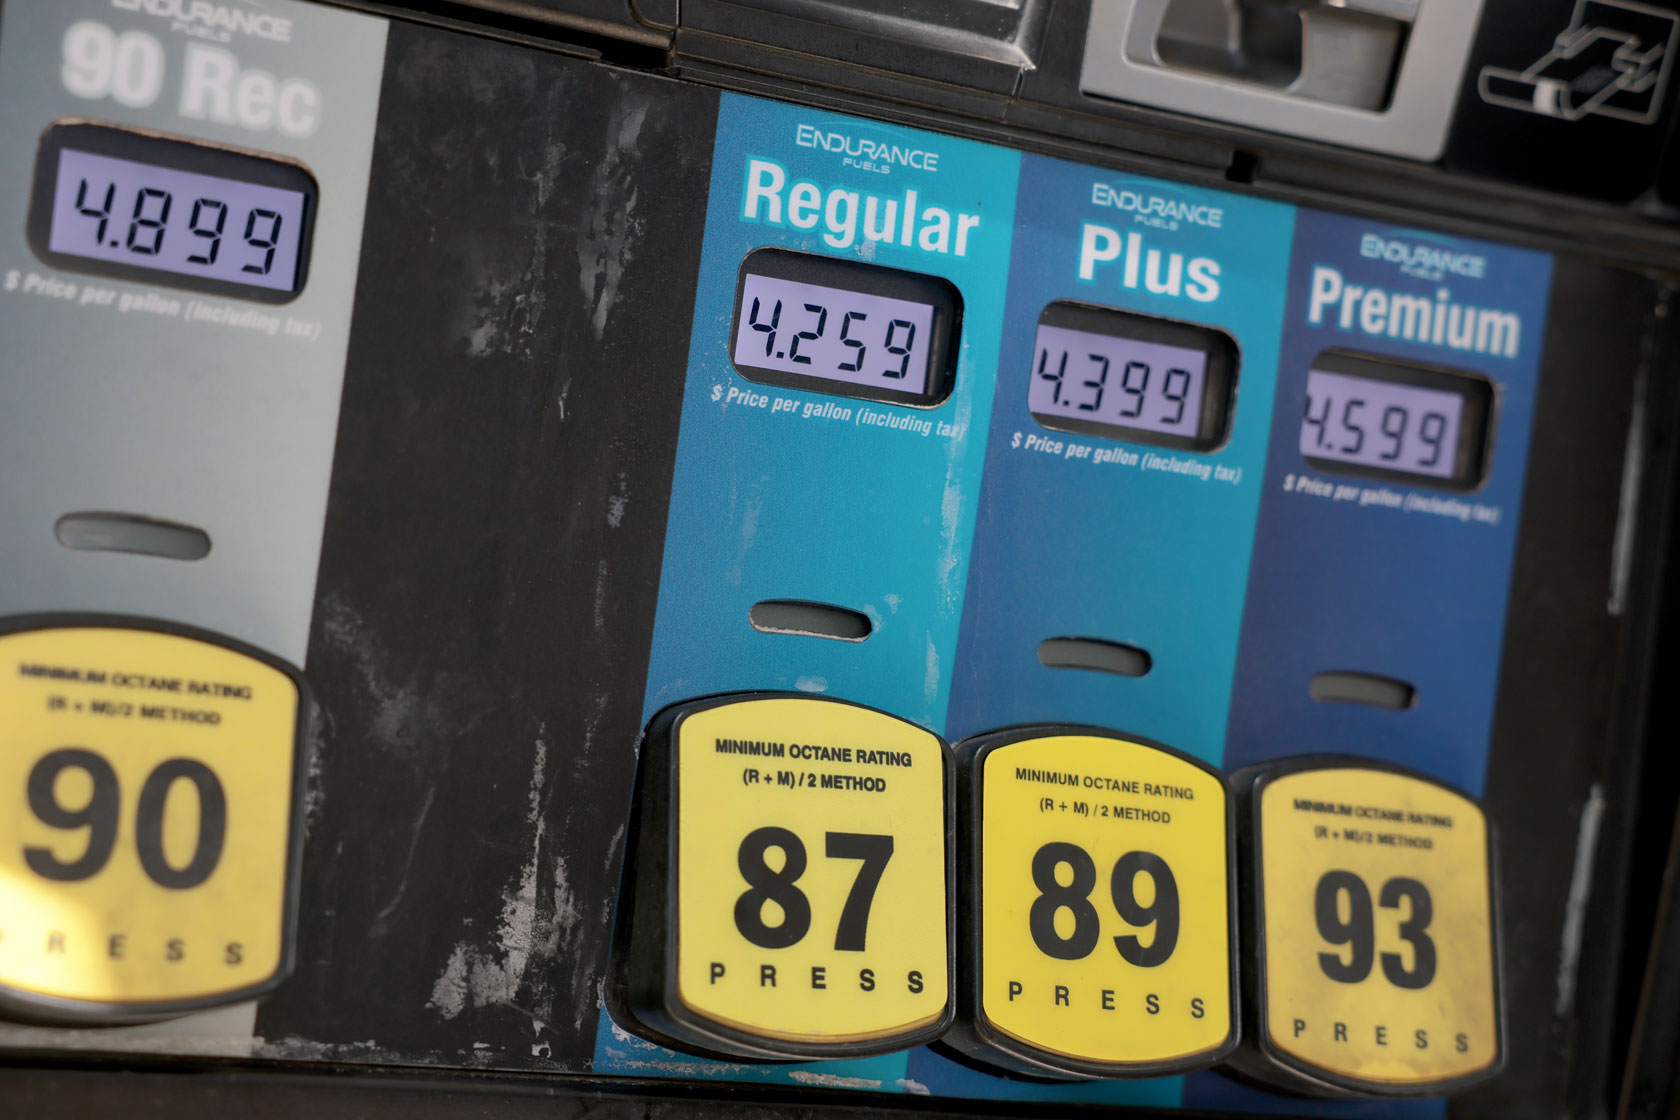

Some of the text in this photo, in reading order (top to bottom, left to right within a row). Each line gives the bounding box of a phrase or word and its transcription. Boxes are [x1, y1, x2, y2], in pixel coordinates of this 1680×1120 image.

[61, 20, 321, 139] 90 Rec
[795, 123, 939, 171] ENDURANCE
[842, 157, 890, 174] FUELS
[75, 178, 282, 276] 4.899
[743, 158, 980, 257] Regular
[1092, 182, 1223, 228] ENDURANCE
[1134, 214, 1179, 231] FUELS
[1078, 222, 1222, 303] Plus
[23, 272, 78, 300] Price
[1308, 266, 1521, 358] Premium
[748, 296, 916, 380] 4.259
[1038, 348, 1191, 425] 4.399
[711, 384, 723, 402] $
[726, 386, 768, 409] Price
[771, 396, 801, 414] per
[802, 402, 852, 422] gallon
[856, 407, 933, 437] (including
[1304, 395, 1447, 468] 4.599
[1011, 432, 1243, 485] $ Price per gallon (including tax)
[112, 671, 181, 692] OCTANE
[187, 680, 253, 700] RATING
[140, 704, 221, 726] METHOD
[715, 738, 912, 768] MINIMUM OCTANE RATING
[743, 768, 760, 786] (R
[763, 773, 773, 785] +
[777, 770, 796, 790] M)
[807, 773, 817, 788] 2
[820, 773, 887, 793] METHOD
[1015, 767, 1195, 800] MINIMUM OCTANE RATING
[22, 746, 227, 890] 90
[1039, 797, 1054, 813] (R
[1058, 800, 1068, 812] +
[1073, 801, 1089, 818] M)
[1100, 805, 1109, 817] 2
[1113, 806, 1172, 824] METHOD
[1356, 805, 1405, 822] OCTANE
[1377, 832, 1434, 850] METHOD
[734, 826, 894, 952] 87
[1029, 841, 1180, 967] 89
[0, 930, 245, 966] RESS
[1314, 869, 1437, 990] 93
[709, 962, 925, 994] PRESS
[1008, 981, 1206, 1019] PRESS
[1293, 1018, 1469, 1053] PRESS
